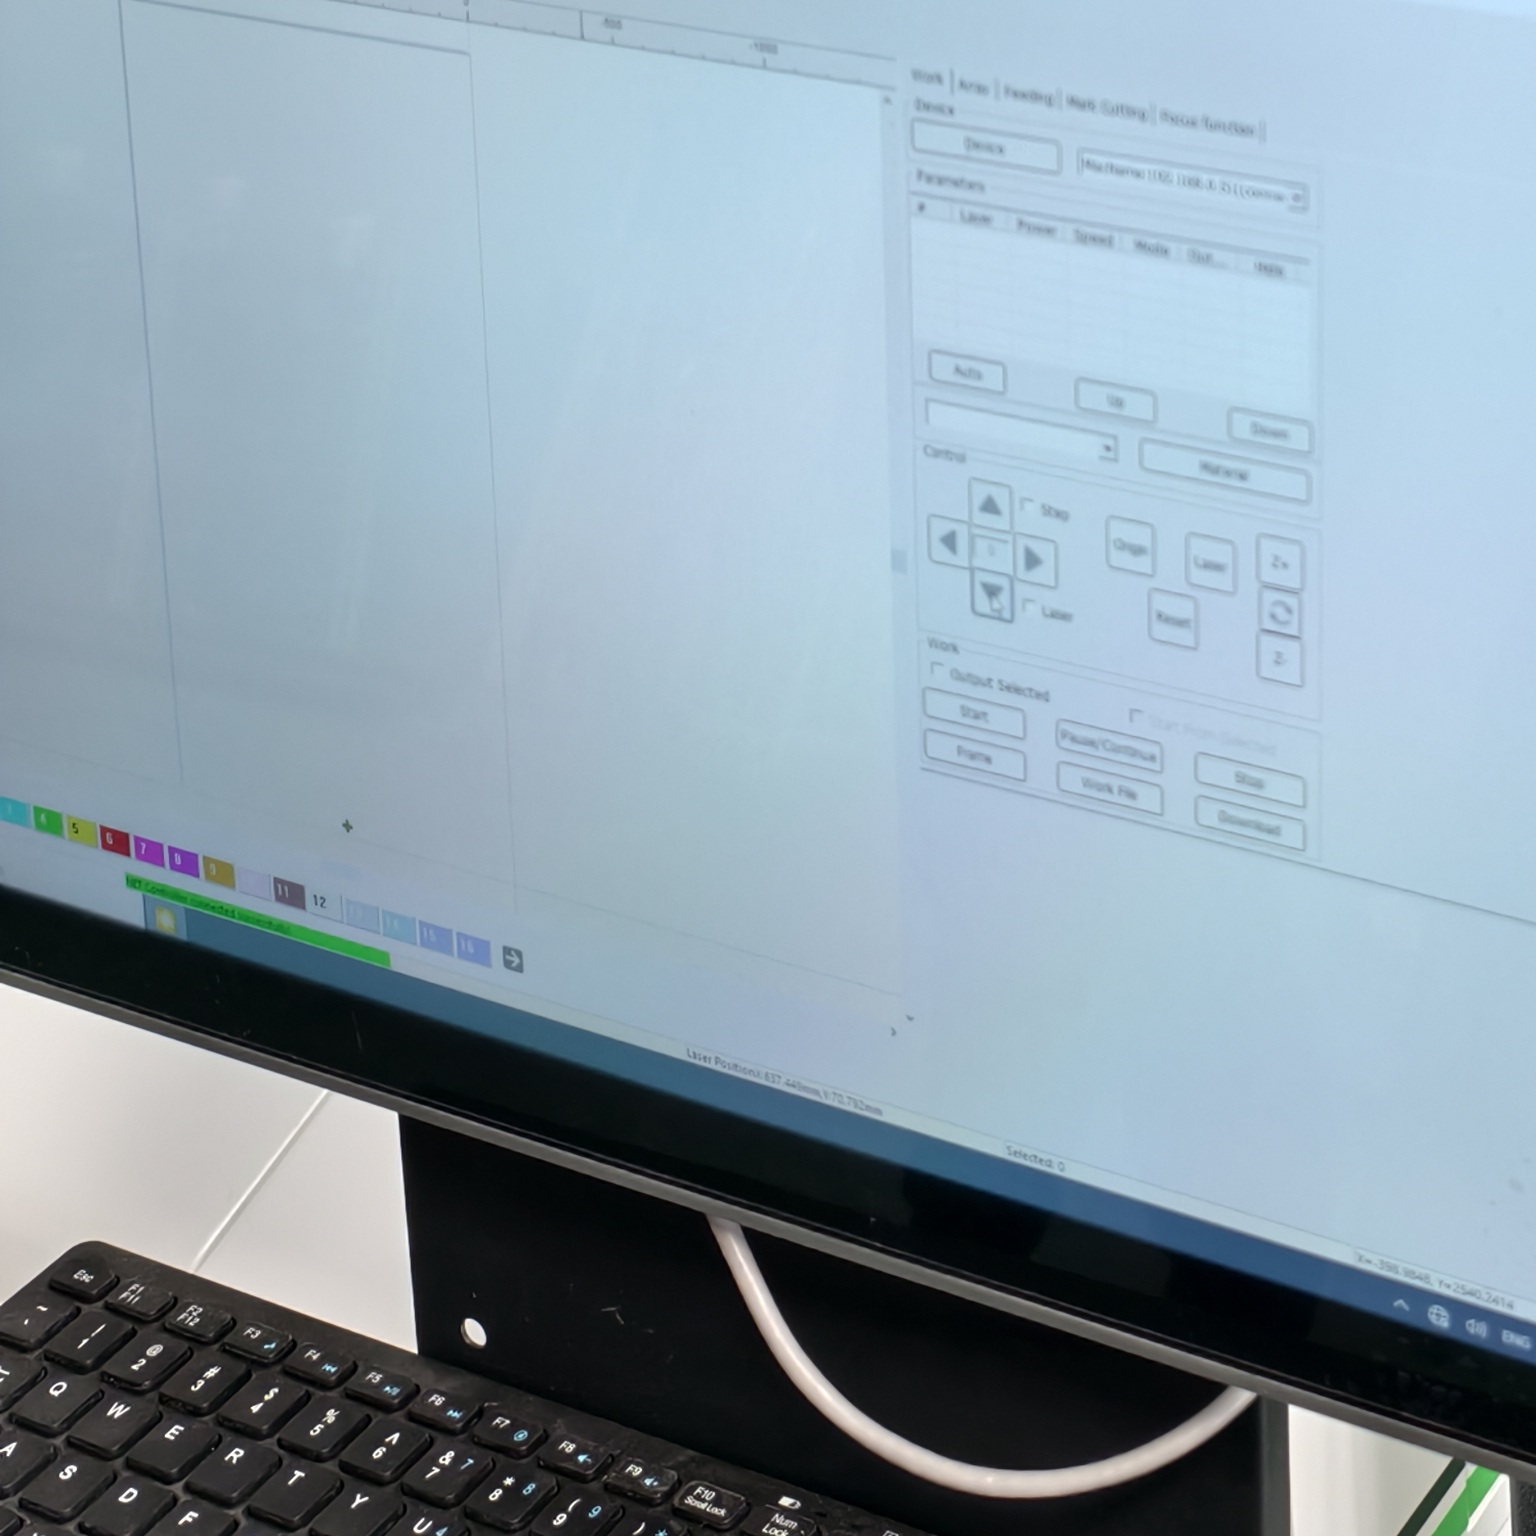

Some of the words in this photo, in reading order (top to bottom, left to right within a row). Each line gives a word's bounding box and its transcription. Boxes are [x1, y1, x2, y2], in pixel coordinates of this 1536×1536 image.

[922, 443, 968, 465] Control
[949, 666, 994, 691] Output
[997, 678, 1052, 704] Selected
[71, 821, 80, 835] 5
[139, 842, 148, 855] 7
[275, 882, 290, 899] 11
[312, 894, 327, 909] 12
[686, 1047, 713, 1066] Laser
[73, 1269, 94, 1283] Esc
[186, 1304, 204, 1317] F2
[176, 1312, 201, 1327] F12
[243, 1326, 262, 1340] F3
[1501, 1328, 1532, 1350] ENG
[146, 1343, 164, 1358] @
[304, 1348, 322, 1362] F4
[130, 1358, 147, 1371] 2
[202, 1365, 222, 1380] #
[365, 1371, 384, 1384] F5
[48, 1381, 68, 1398] Q
[190, 1379, 206, 1392] 3
[263, 1387, 279, 1402] $
[428, 1393, 446, 1407] F6
[105, 1401, 132, 1420] W
[249, 1402, 264, 1414] 4
[321, 1407, 341, 1425] %
[491, 1415, 511, 1429] F7
[164, 1424, 185, 1442] E
[309, 1423, 325, 1437] 5
[371, 1446, 388, 1460] 6
[557, 1439, 577, 1455] F8
[224, 1447, 245, 1465] R
[438, 1450, 456, 1467] &
[460, 1457, 475, 1471] 7
[624, 1463, 643, 1477] F9
[58, 1464, 78, 1481] S
[287, 1469, 306, 1487] T
[424, 1465, 441, 1480] 7
[118, 1487, 139, 1504] D
[488, 1488, 503, 1502] 8
[521, 1482, 537, 1496] 8
[692, 1485, 716, 1501] F10
[349, 1493, 370, 1510] Y
[683, 1495, 706, 1512] Scroll
[706, 1501, 728, 1519] Lock
[177, 1510, 200, 1526] F
[552, 1512, 568, 1527] 9
[588, 1505, 602, 1519] 9
[412, 1517, 433, 1535] U
[771, 1512, 799, 1530] Num
